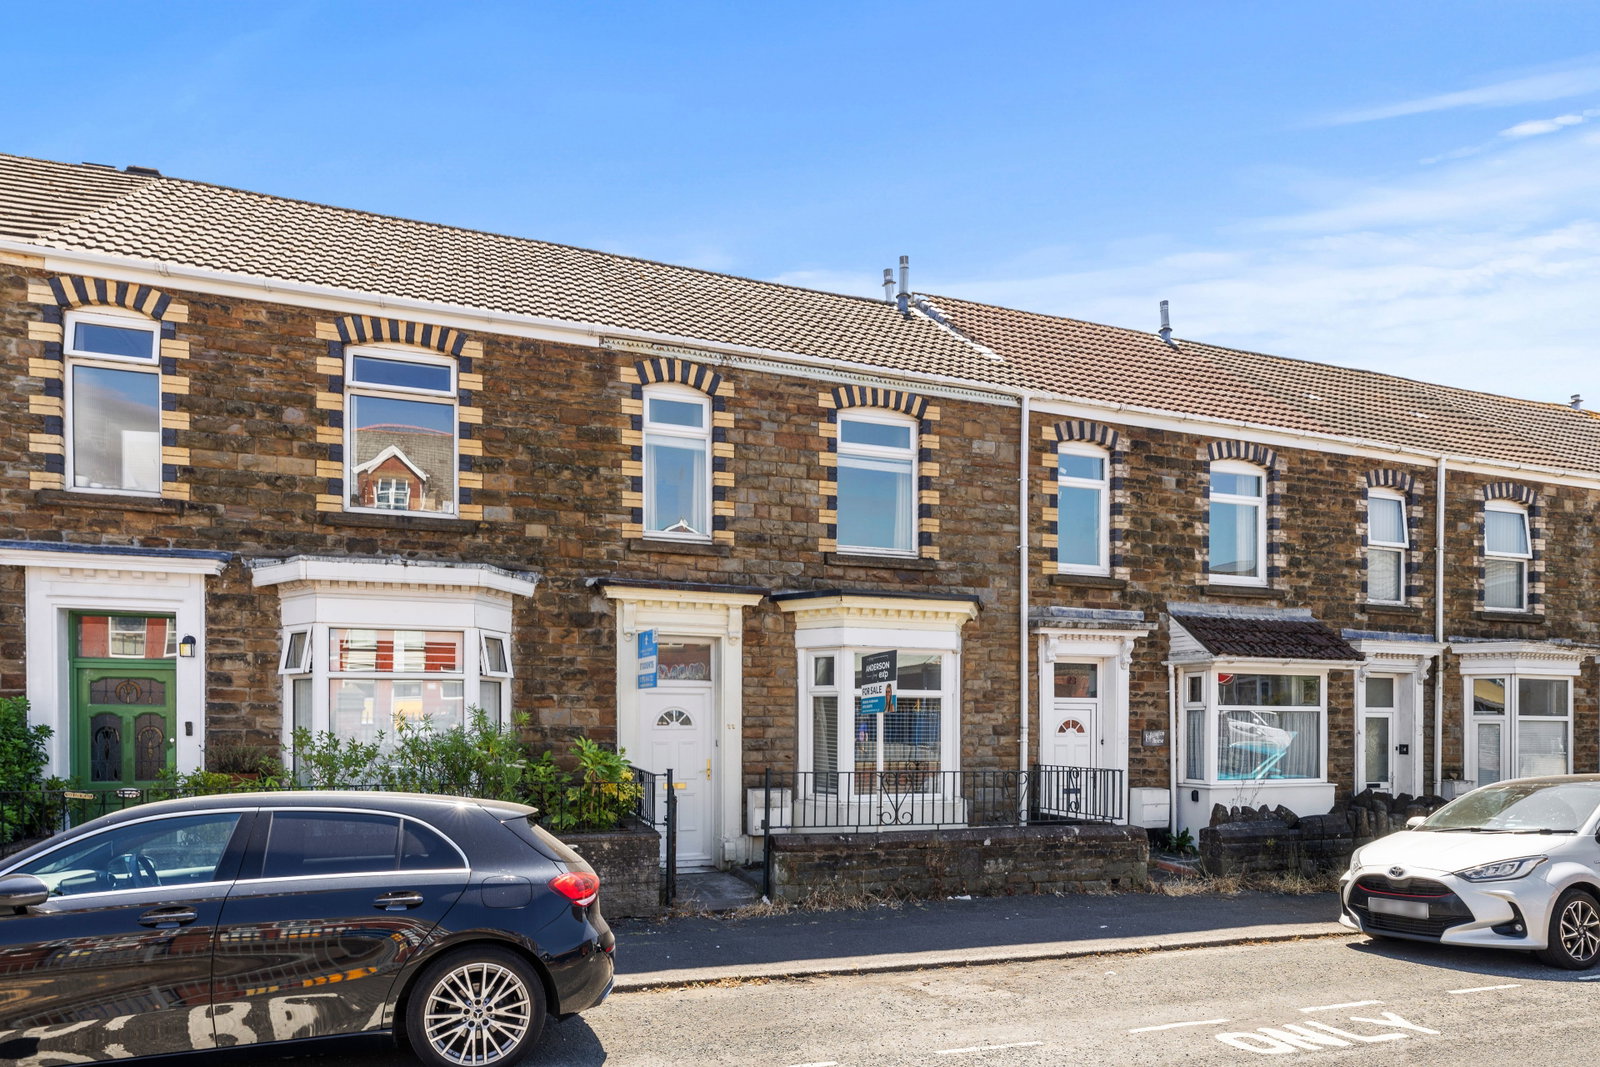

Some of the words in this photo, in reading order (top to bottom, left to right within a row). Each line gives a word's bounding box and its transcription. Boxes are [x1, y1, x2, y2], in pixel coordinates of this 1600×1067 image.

[866, 662, 890, 672] ANDERSON
[870, 686, 882, 694] SALE
[1214, 1011, 1442, 1055] ONLY
